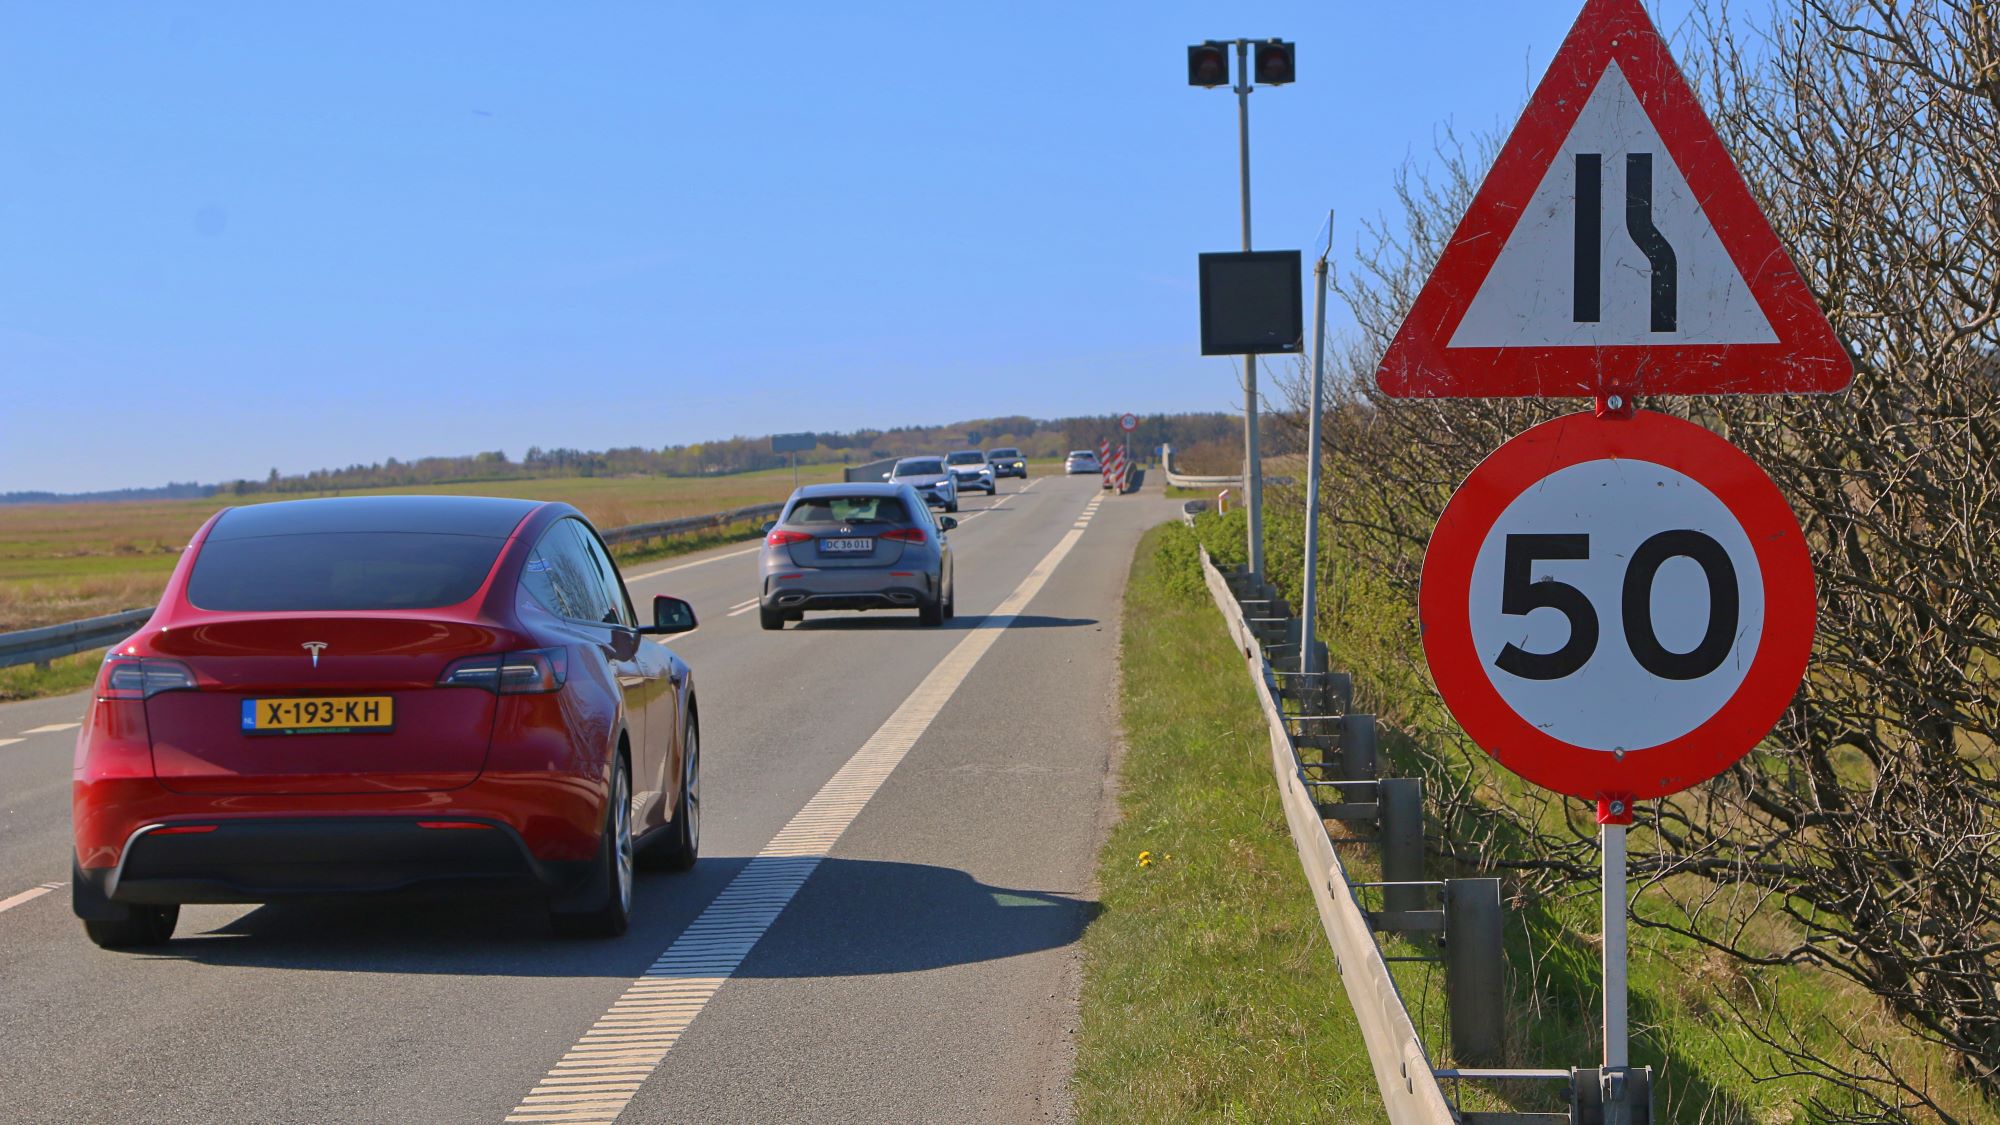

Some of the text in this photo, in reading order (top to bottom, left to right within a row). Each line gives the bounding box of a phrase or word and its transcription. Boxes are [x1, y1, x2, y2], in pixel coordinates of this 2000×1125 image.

[841, 541, 852, 549] 36
[854, 540, 870, 548] 011
[1494, 529, 1740, 681] 50
[268, 701, 379, 724] X-193-KH
